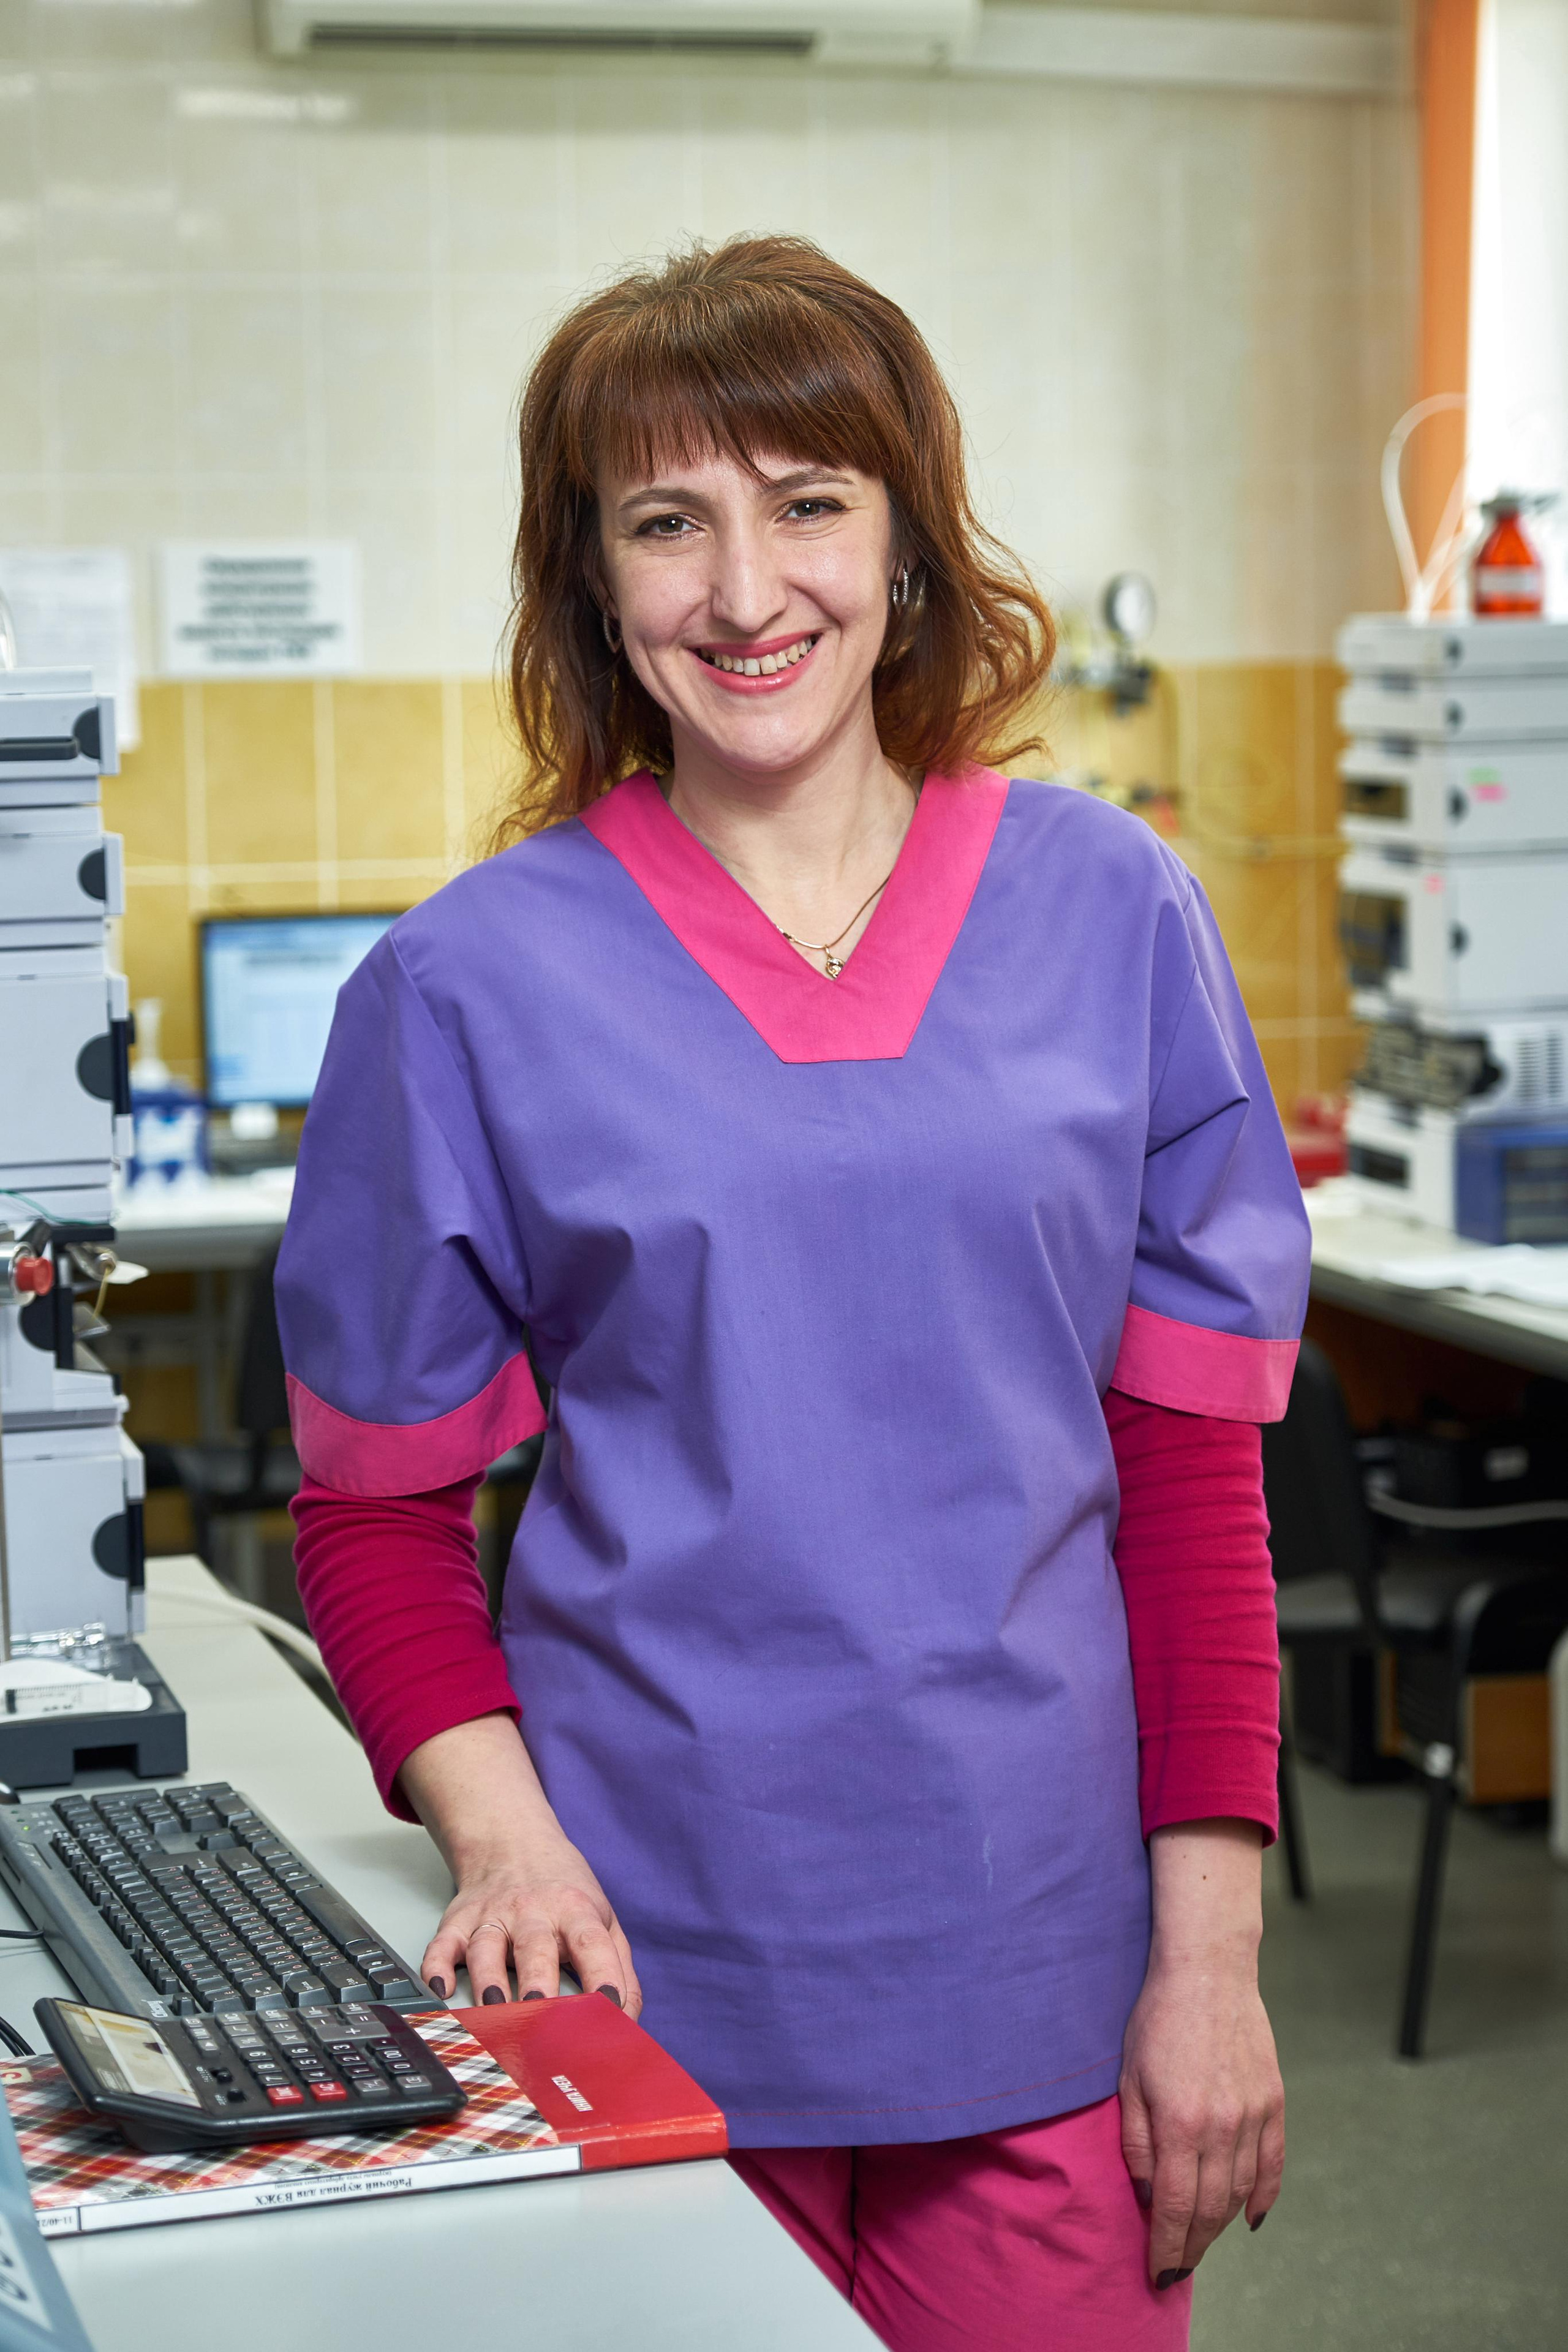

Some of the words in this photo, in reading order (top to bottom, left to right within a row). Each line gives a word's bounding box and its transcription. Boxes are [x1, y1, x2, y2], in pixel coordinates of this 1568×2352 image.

[309, 2007, 323, 2015] M-
[347, 2003, 363, 2011] M+
[224, 2013, 241, 2021] MC
[266, 2010, 282, 2018] MR
[566, 2092, 593, 2111] КНИГА
[320, 2183, 361, 2195] журнал
[366, 2177, 412, 2192] Рабочий
[296, 2189, 316, 2198] для
[255, 2193, 292, 2206] ВЭЖХ
